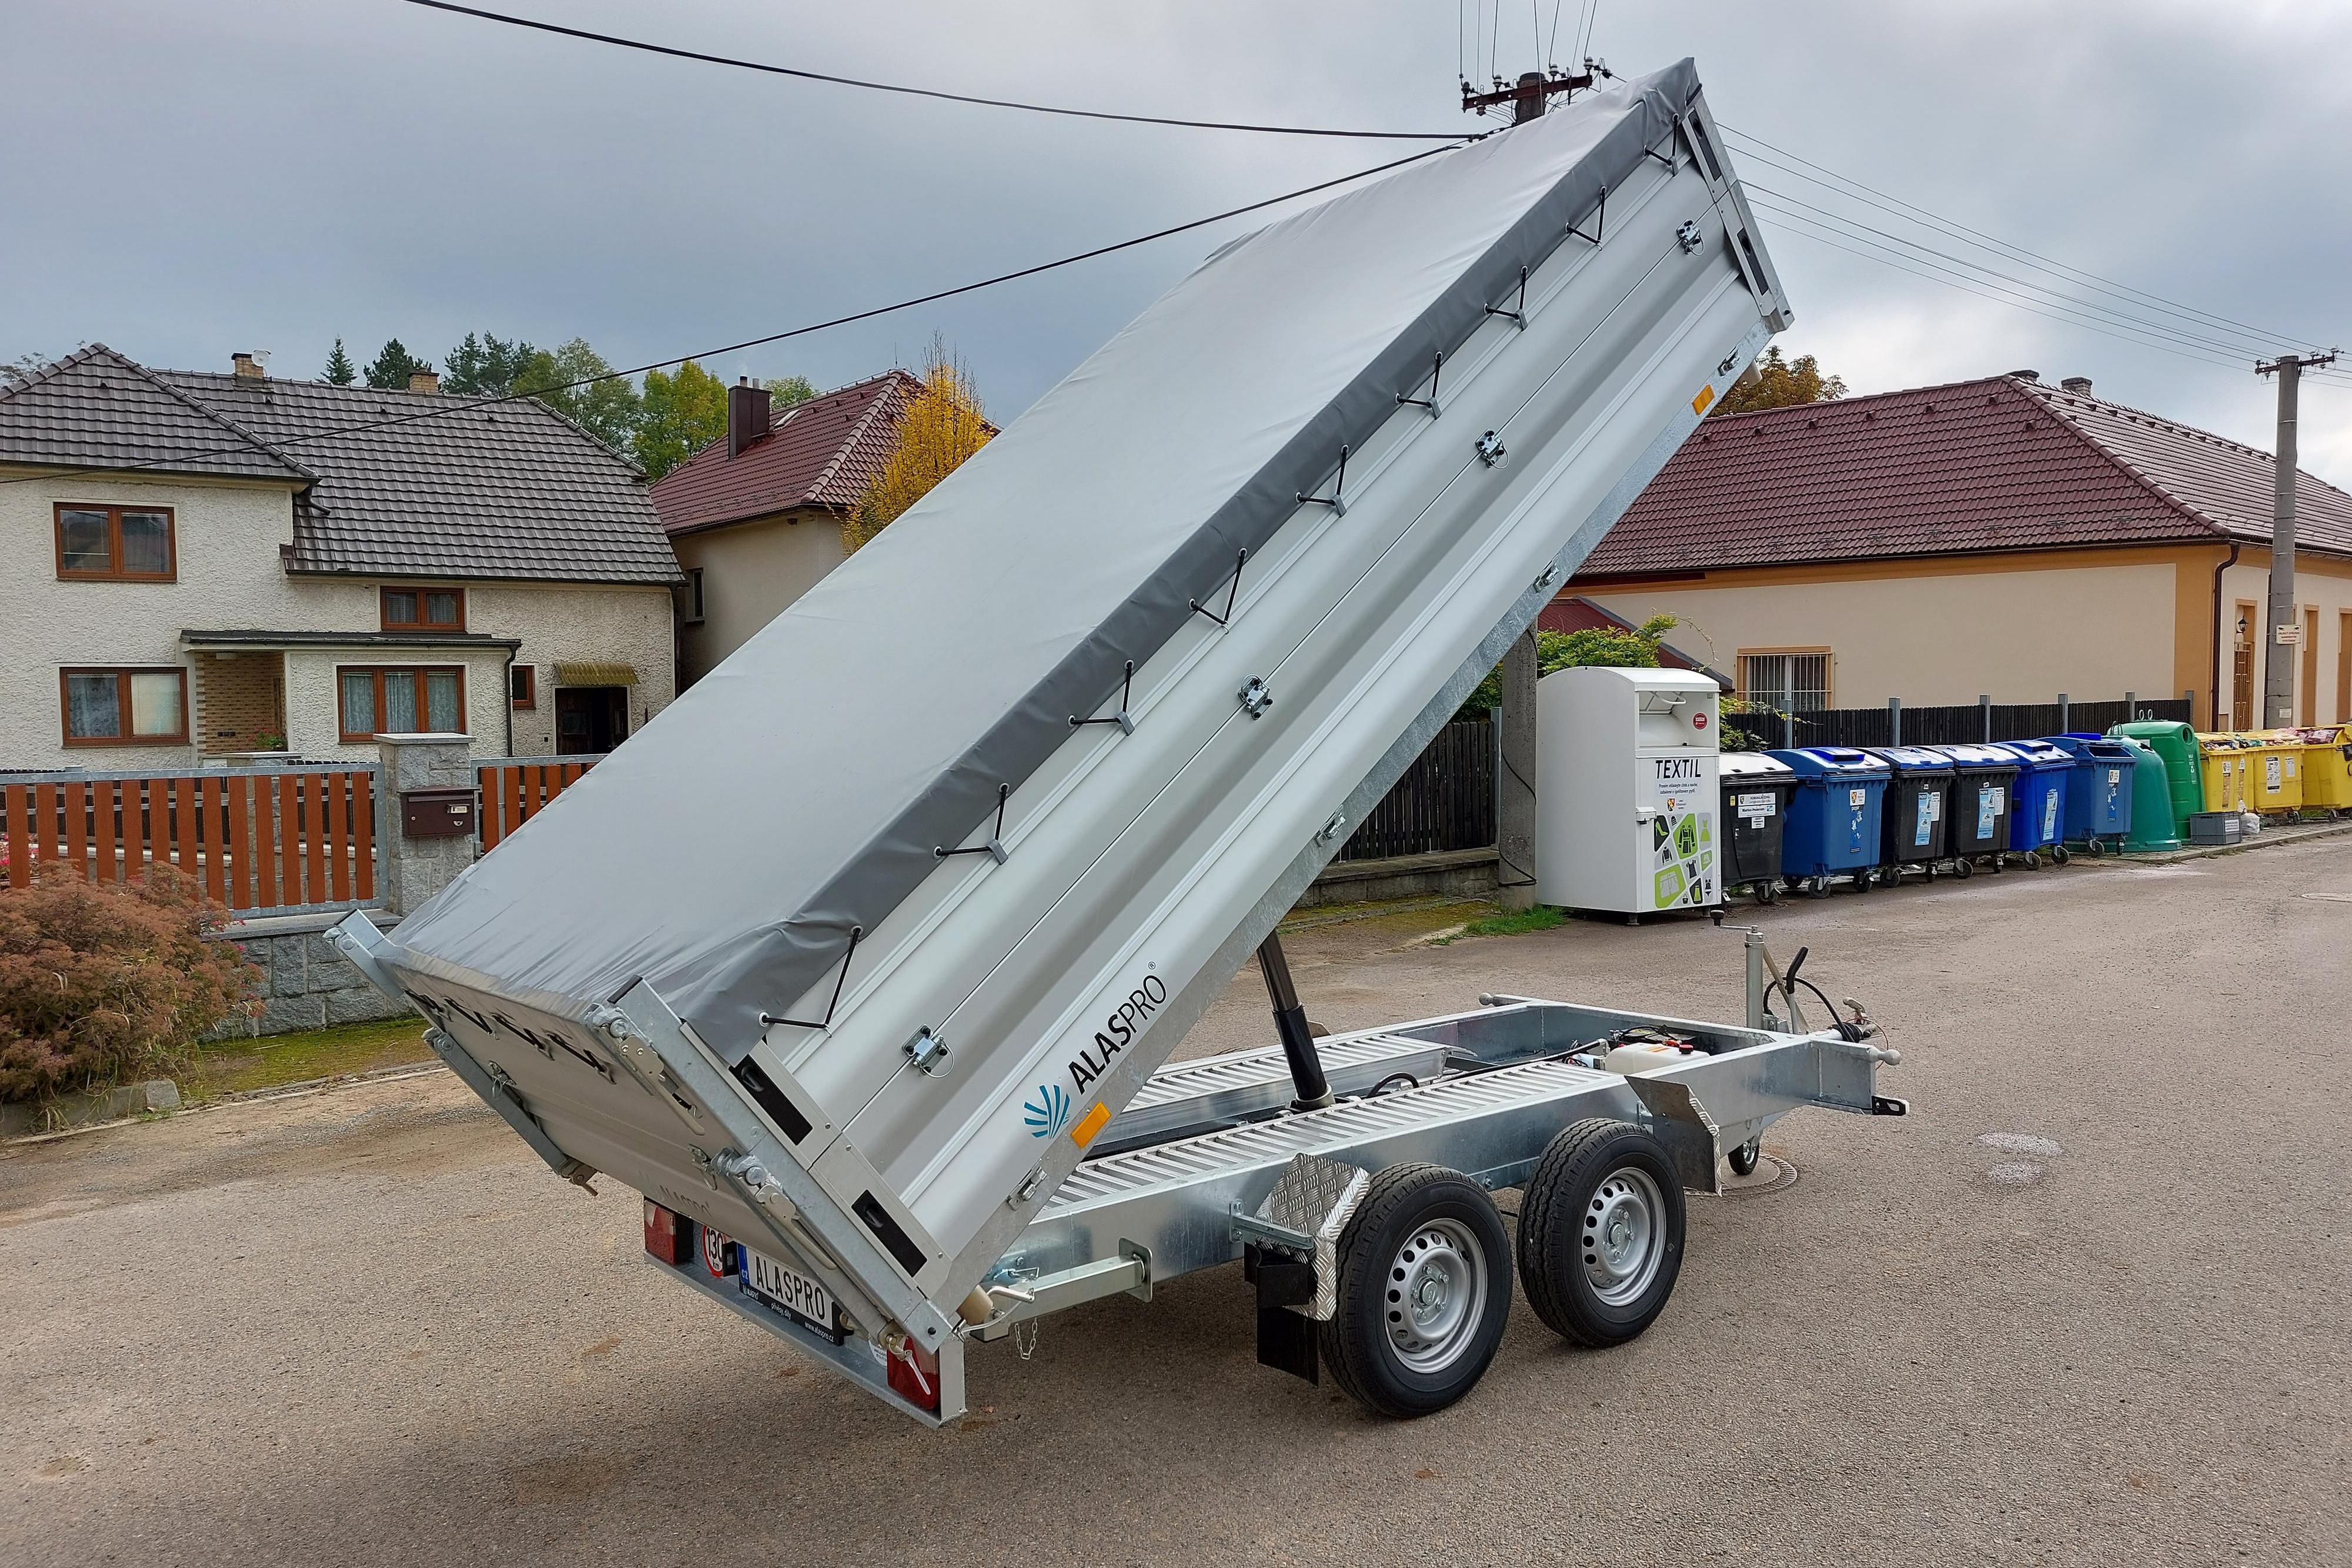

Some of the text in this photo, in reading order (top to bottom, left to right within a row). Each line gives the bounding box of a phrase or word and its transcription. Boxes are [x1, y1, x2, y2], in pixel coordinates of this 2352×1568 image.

[1655, 759, 1702, 779] TEXTIL
[706, 1228, 723, 1263] 130
[712, 1259, 720, 1271] km
[741, 1269, 749, 1280] CZ
[756, 1256, 825, 1320] ALASPRO
[804, 1322, 834, 1343] www.alaspro.cz
